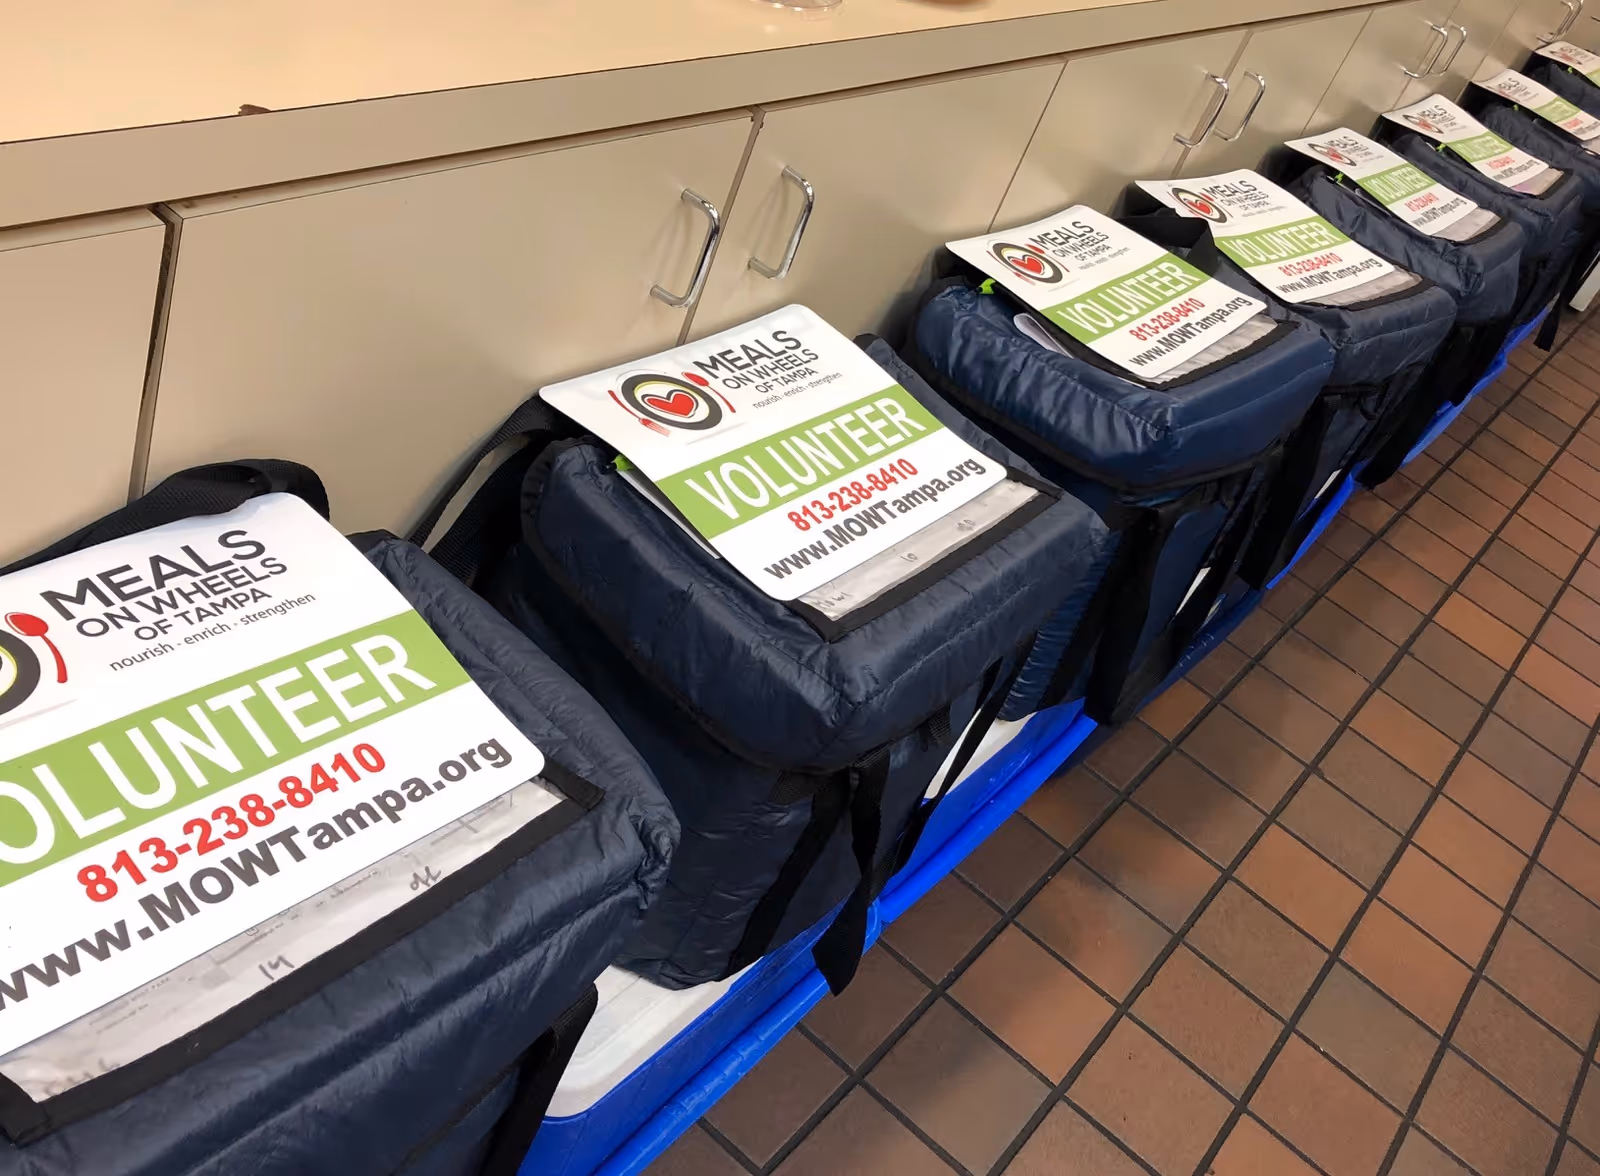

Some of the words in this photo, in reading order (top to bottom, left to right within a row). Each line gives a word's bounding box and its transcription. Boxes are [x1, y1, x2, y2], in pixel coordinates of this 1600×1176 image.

[1202, 180, 1257, 199] MEALS
[1028, 221, 1094, 250] MEALS
[1067, 231, 1109, 252] WHEELS
[1223, 222, 1341, 264] VOLUNTEER
[1276, 257, 1383, 294] www.MOWTampa.org
[1278, 252, 1343, 276] 813-238-8410
[1055, 261, 1202, 335] VOLUNTEER
[1128, 297, 1206, 341] 813-238-8410
[692, 330, 802, 379] MEALS
[1128, 295, 1253, 367] www.MOWTampa.org
[722, 373, 755, 389] ON
[747, 348, 819, 380] WHEELS
[752, 394, 782, 409] nourish
[784, 385, 805, 397] enrich
[807, 371, 843, 389] strengthen
[755, 381, 774, 393] OF
[775, 366, 818, 387] TAMPA
[685, 397, 926, 520] VOLUNTEER
[764, 456, 986, 580] www.MOWTampa.org
[787, 458, 919, 532] 813-238-8410
[40, 530, 266, 621] MEALS
[76, 606, 138, 637] ON
[136, 557, 287, 616] WHEELS
[109, 641, 175, 671] nourish
[184, 622, 231, 646] enrich
[240, 592, 316, 626] strengthen
[134, 618, 176, 641] OF
[174, 588, 272, 626] TAMPA
[0, 634, 437, 865] OLUNTEER
[77, 743, 386, 902] 813-238-8410
